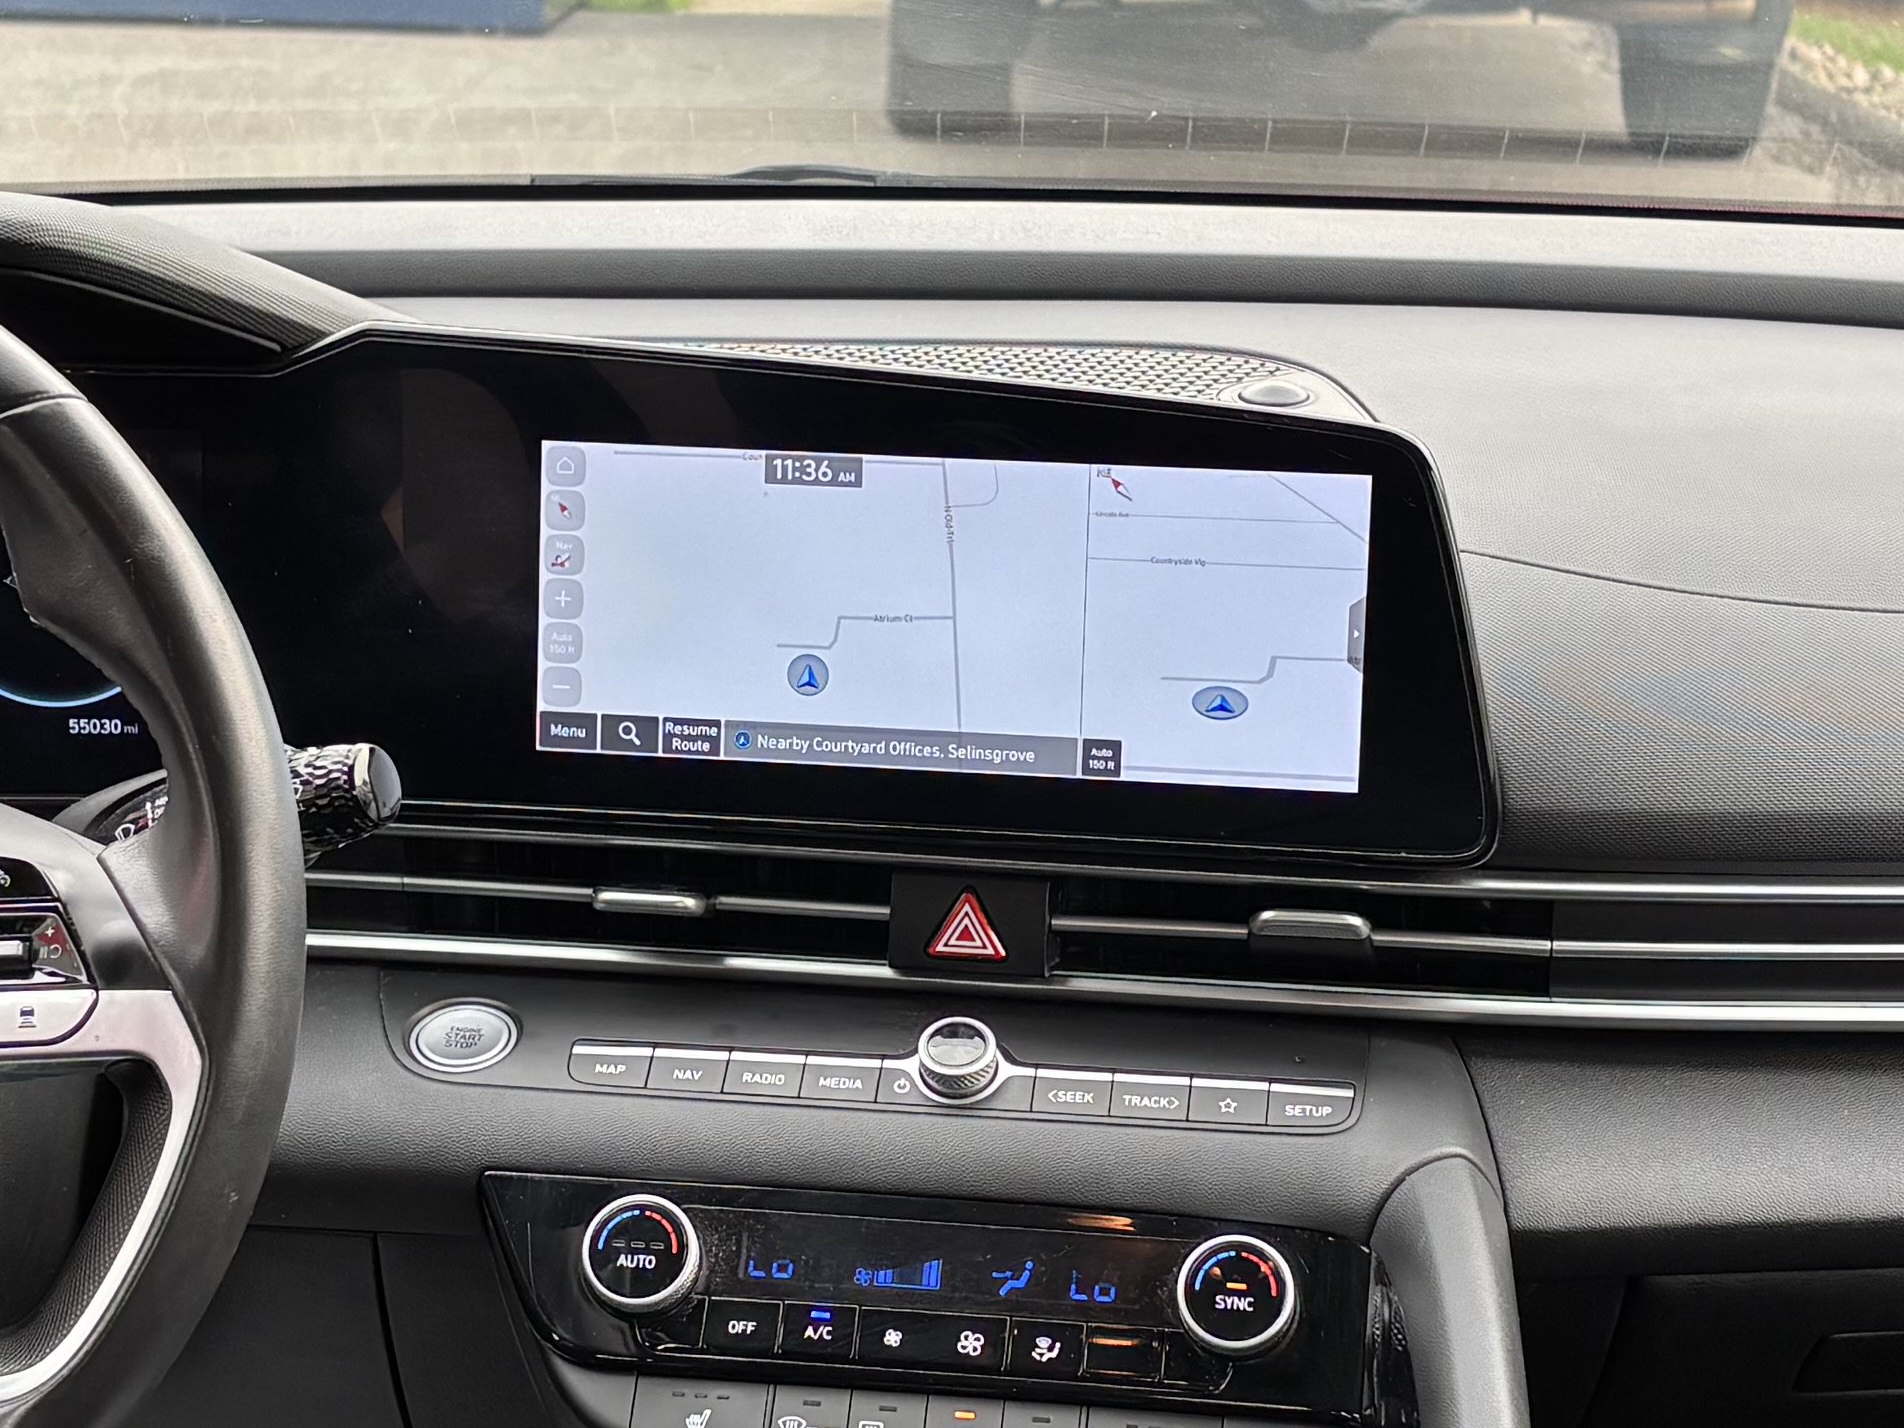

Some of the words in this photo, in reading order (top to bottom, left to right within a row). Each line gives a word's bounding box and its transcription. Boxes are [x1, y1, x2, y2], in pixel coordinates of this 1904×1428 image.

[772, 458, 833, 483] 11:36
[837, 471, 856, 483] AM
[556, 541, 573, 550] Nav
[1150, 557, 1193, 568] Countryside
[873, 613, 901, 623] Atrium
[68, 718, 122, 735] 55030
[123, 723, 139, 735] mi
[550, 724, 587, 739] Menu
[664, 721, 718, 737] Resume
[671, 737, 711, 753] Route
[756, 734, 810, 754] Nearby
[812, 737, 886, 757] Courtyard
[948, 744, 1035, 764] Selinsgrove
[1090, 747, 1113, 758] Auto
[1088, 759, 1106, 771] 150
[449, 1025, 484, 1036] ENGINE
[443, 1032, 484, 1044] START
[444, 1038, 479, 1049] STOP
[594, 1064, 626, 1076] MAP
[672, 1068, 702, 1081] NAV
[742, 1072, 785, 1086] RADIO
[818, 1076, 863, 1090] MEDIA
[1284, 1104, 1333, 1119] SETUP
[616, 1253, 656, 1269] AUTO
[1214, 1295, 1254, 1312] SYNC
[727, 1320, 757, 1335] OFF
[803, 1326, 833, 1341] A/C
